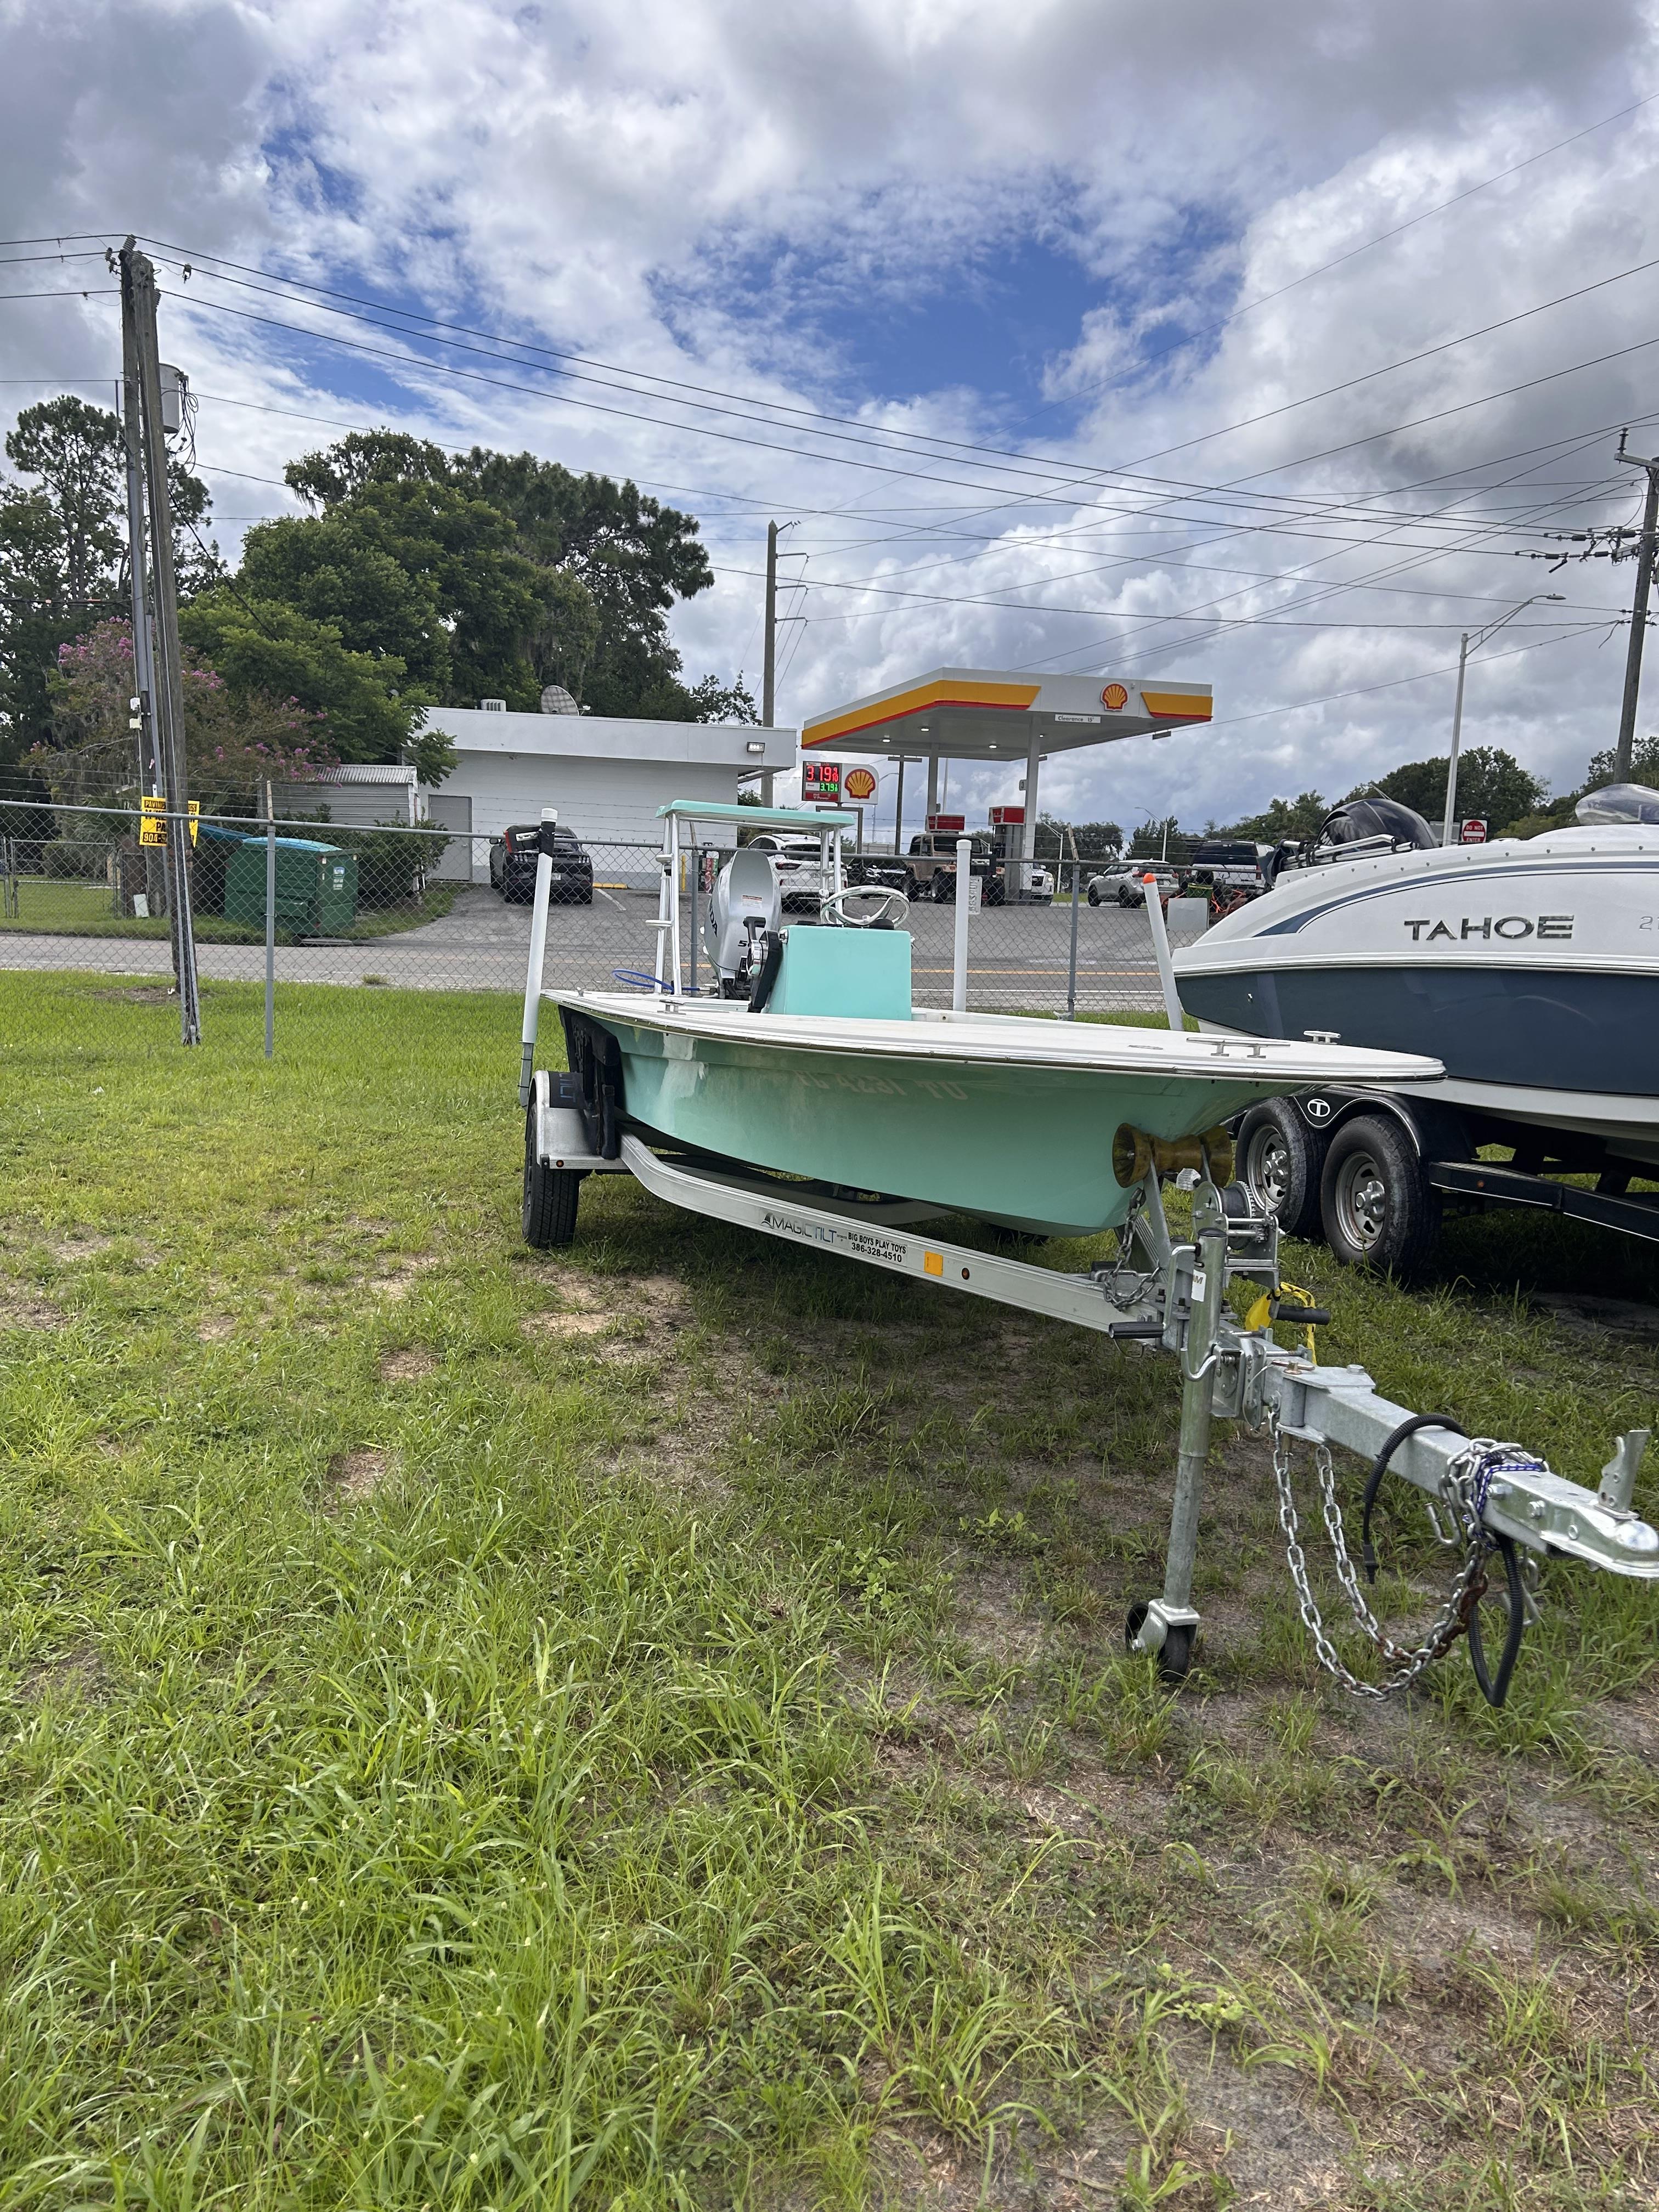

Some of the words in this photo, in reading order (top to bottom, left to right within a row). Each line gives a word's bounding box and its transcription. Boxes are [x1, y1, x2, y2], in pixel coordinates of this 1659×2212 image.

[1404, 915, 1575, 941] TAHOE
[848, 1232, 857, 1242] BIG
[859, 1235, 874, 1246] BOYS
[875, 1239, 890, 1250] PLAY
[891, 1243, 906, 1254] TOYS
[851, 1242, 902, 1262] 386-328-4510
